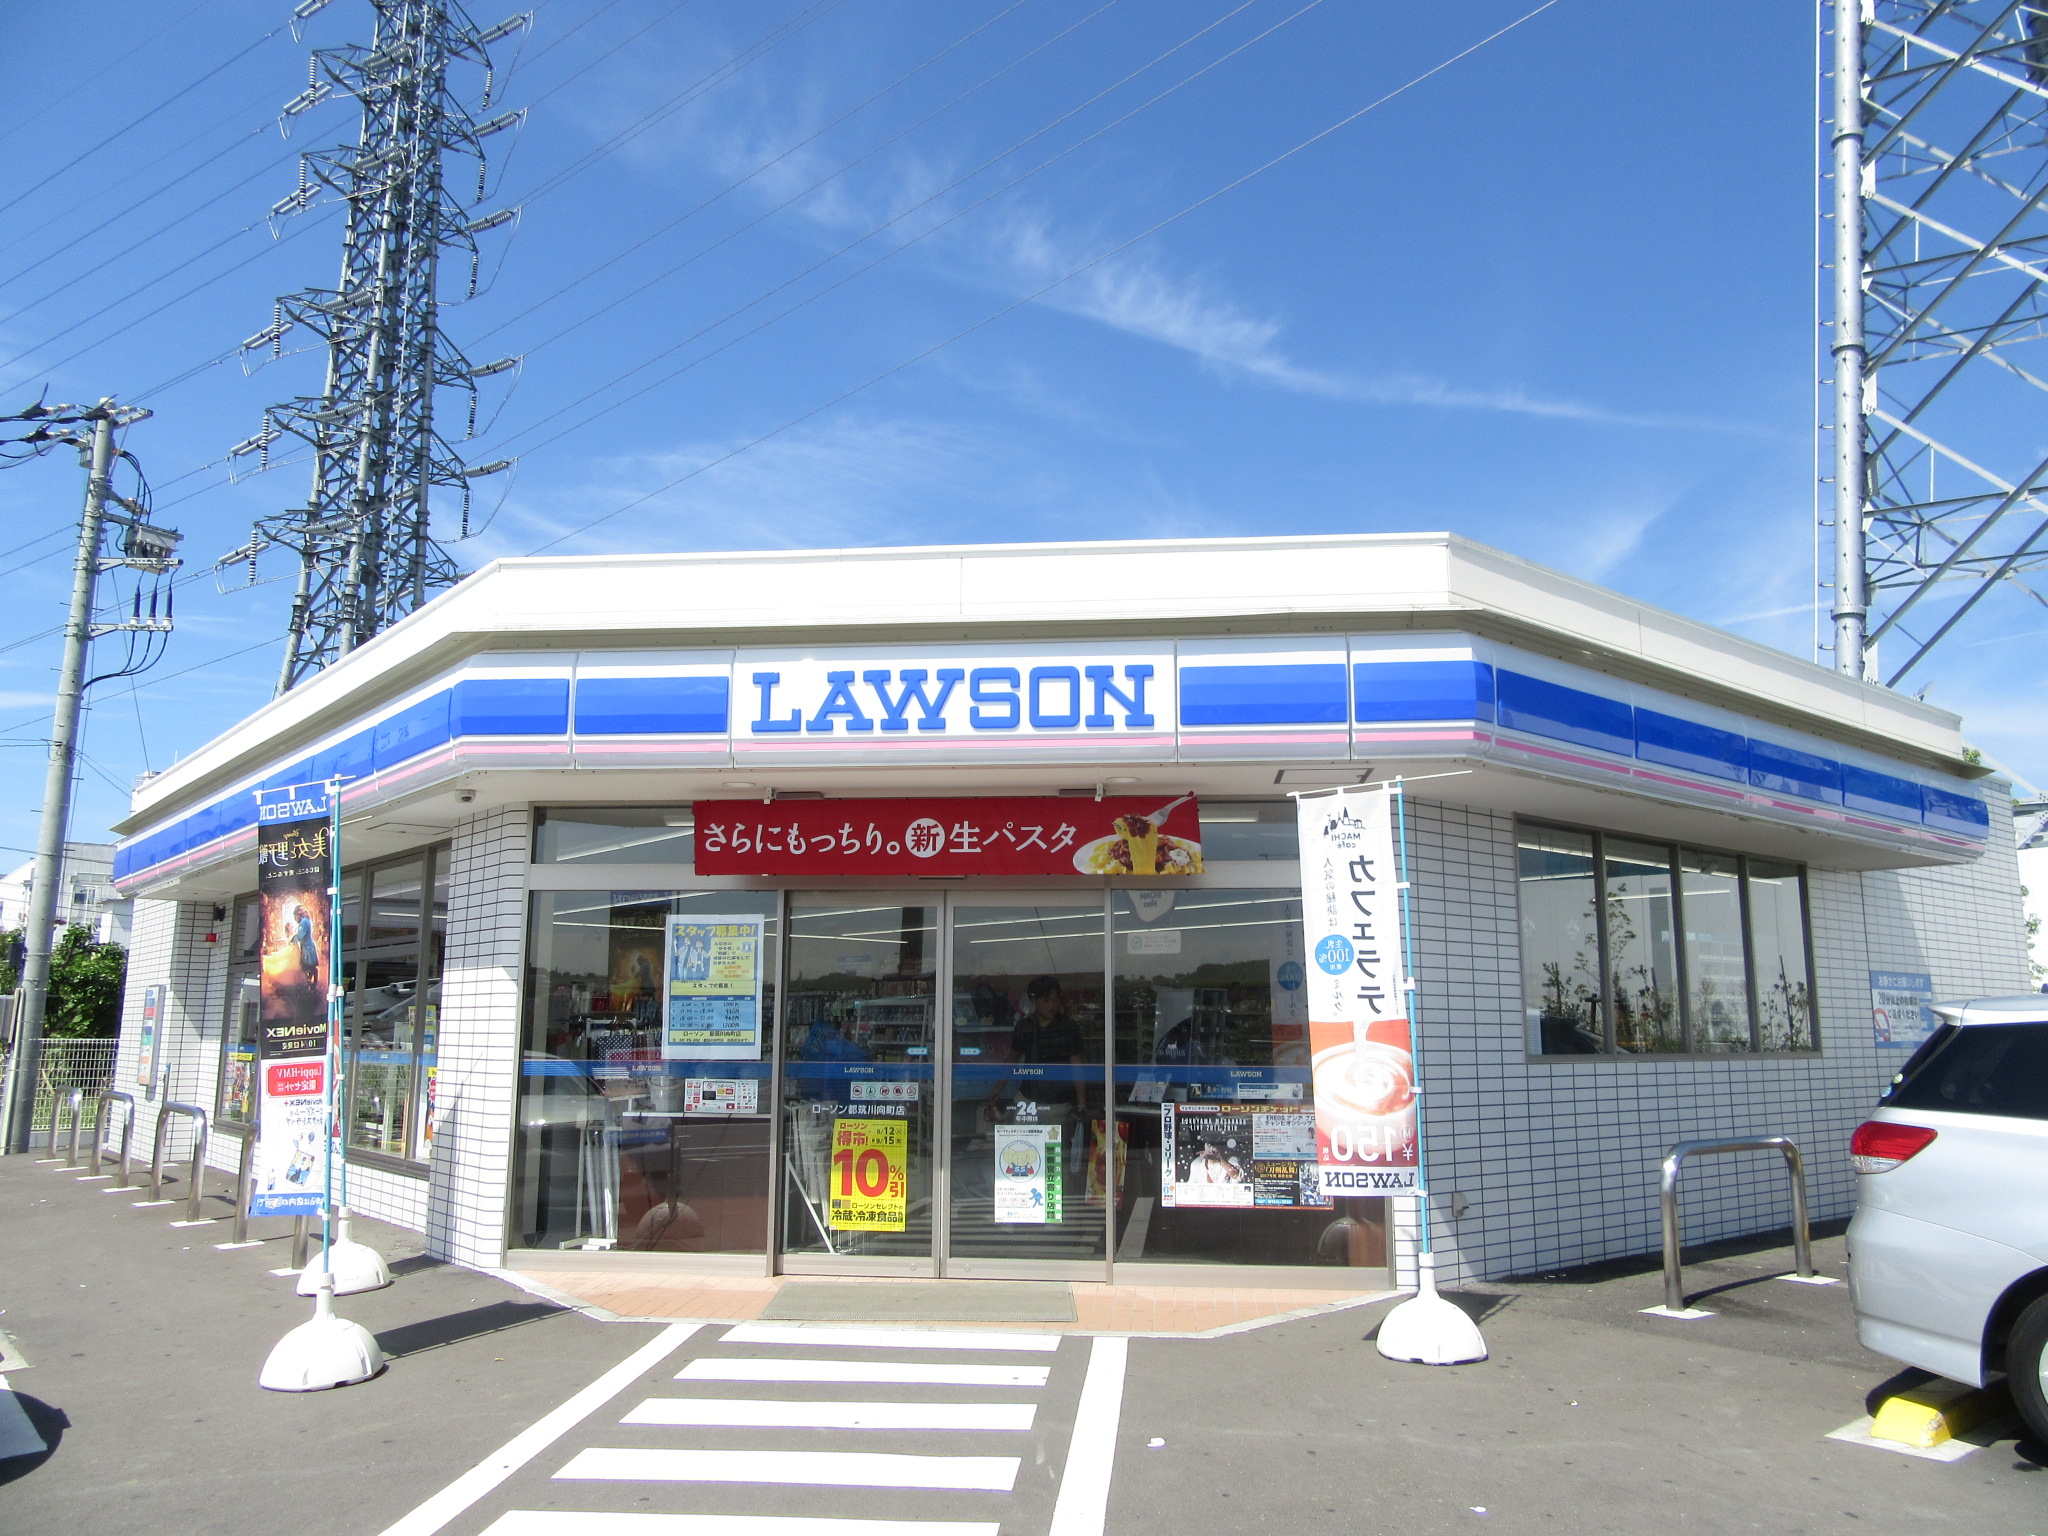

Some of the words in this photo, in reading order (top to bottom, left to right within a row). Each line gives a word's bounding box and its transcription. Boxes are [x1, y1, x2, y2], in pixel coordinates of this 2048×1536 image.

[751, 664, 1154, 733] LAWSON
[1229, 1070, 1263, 1078] LAWSON
[812, 1104, 905, 1116] ローソン都筑川向町店
[1016, 1101, 1038, 1116] 24
[1221, 1105, 1298, 1113] ローソンチケット
[839, 1122, 868, 1130] ローソン
[833, 1148, 889, 1197] 10
[852, 1202, 903, 1210] ローソンセレクトの
[831, 1209, 898, 1223] 冷蔵・冷凍食品
